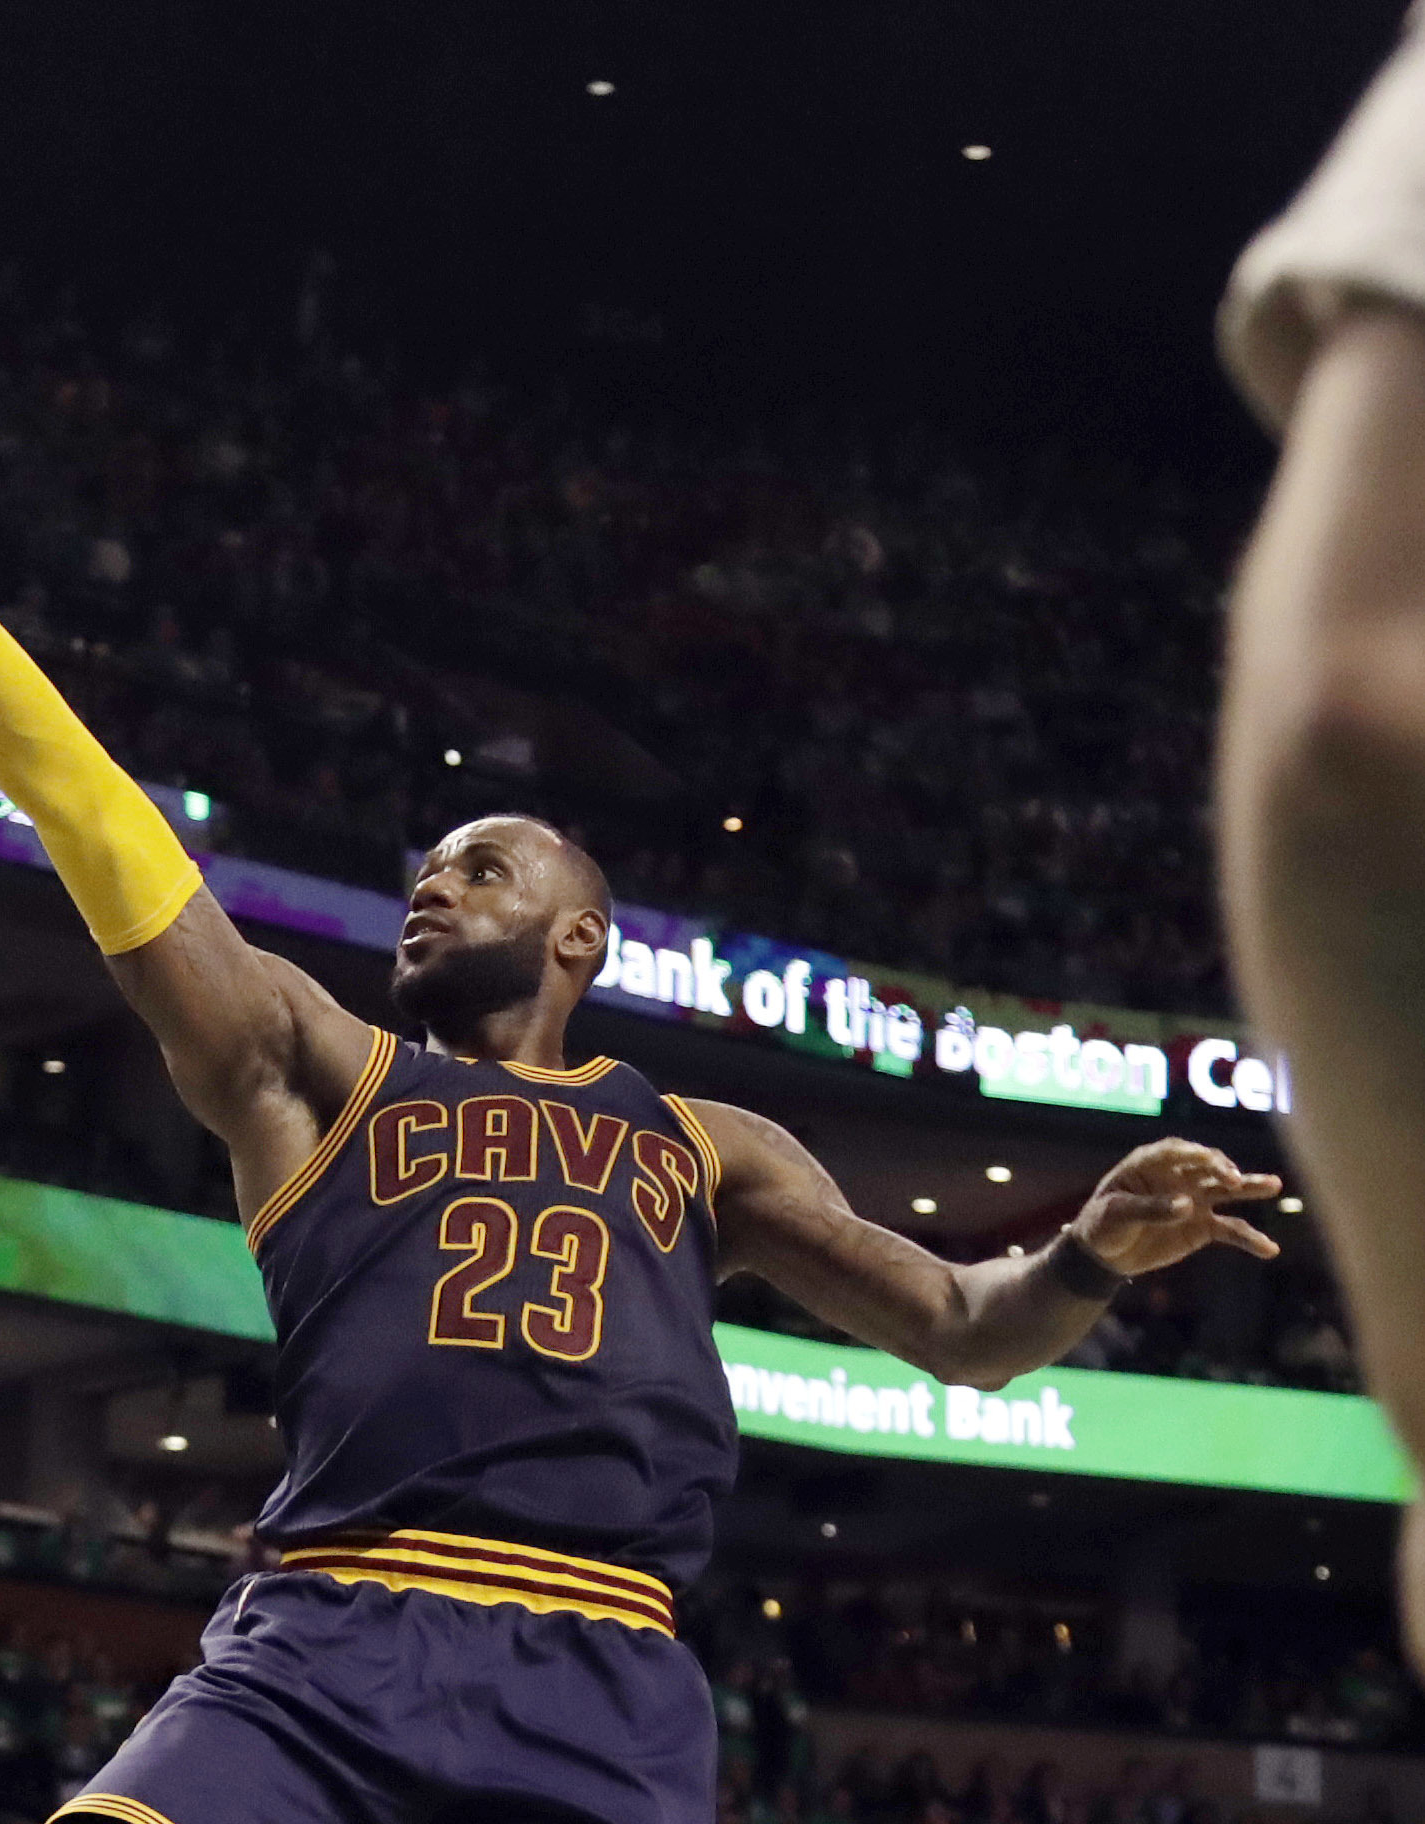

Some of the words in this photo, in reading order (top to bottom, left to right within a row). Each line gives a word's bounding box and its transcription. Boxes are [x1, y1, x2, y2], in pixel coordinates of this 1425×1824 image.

[743, 958, 812, 1035] of
[824, 976, 922, 1062] the
[368, 1094, 698, 1253] CAVS
[428, 1196, 610, 1362] 23
[721, 1359, 937, 1440] nvenient
[944, 1384, 1077, 1451] Bank
